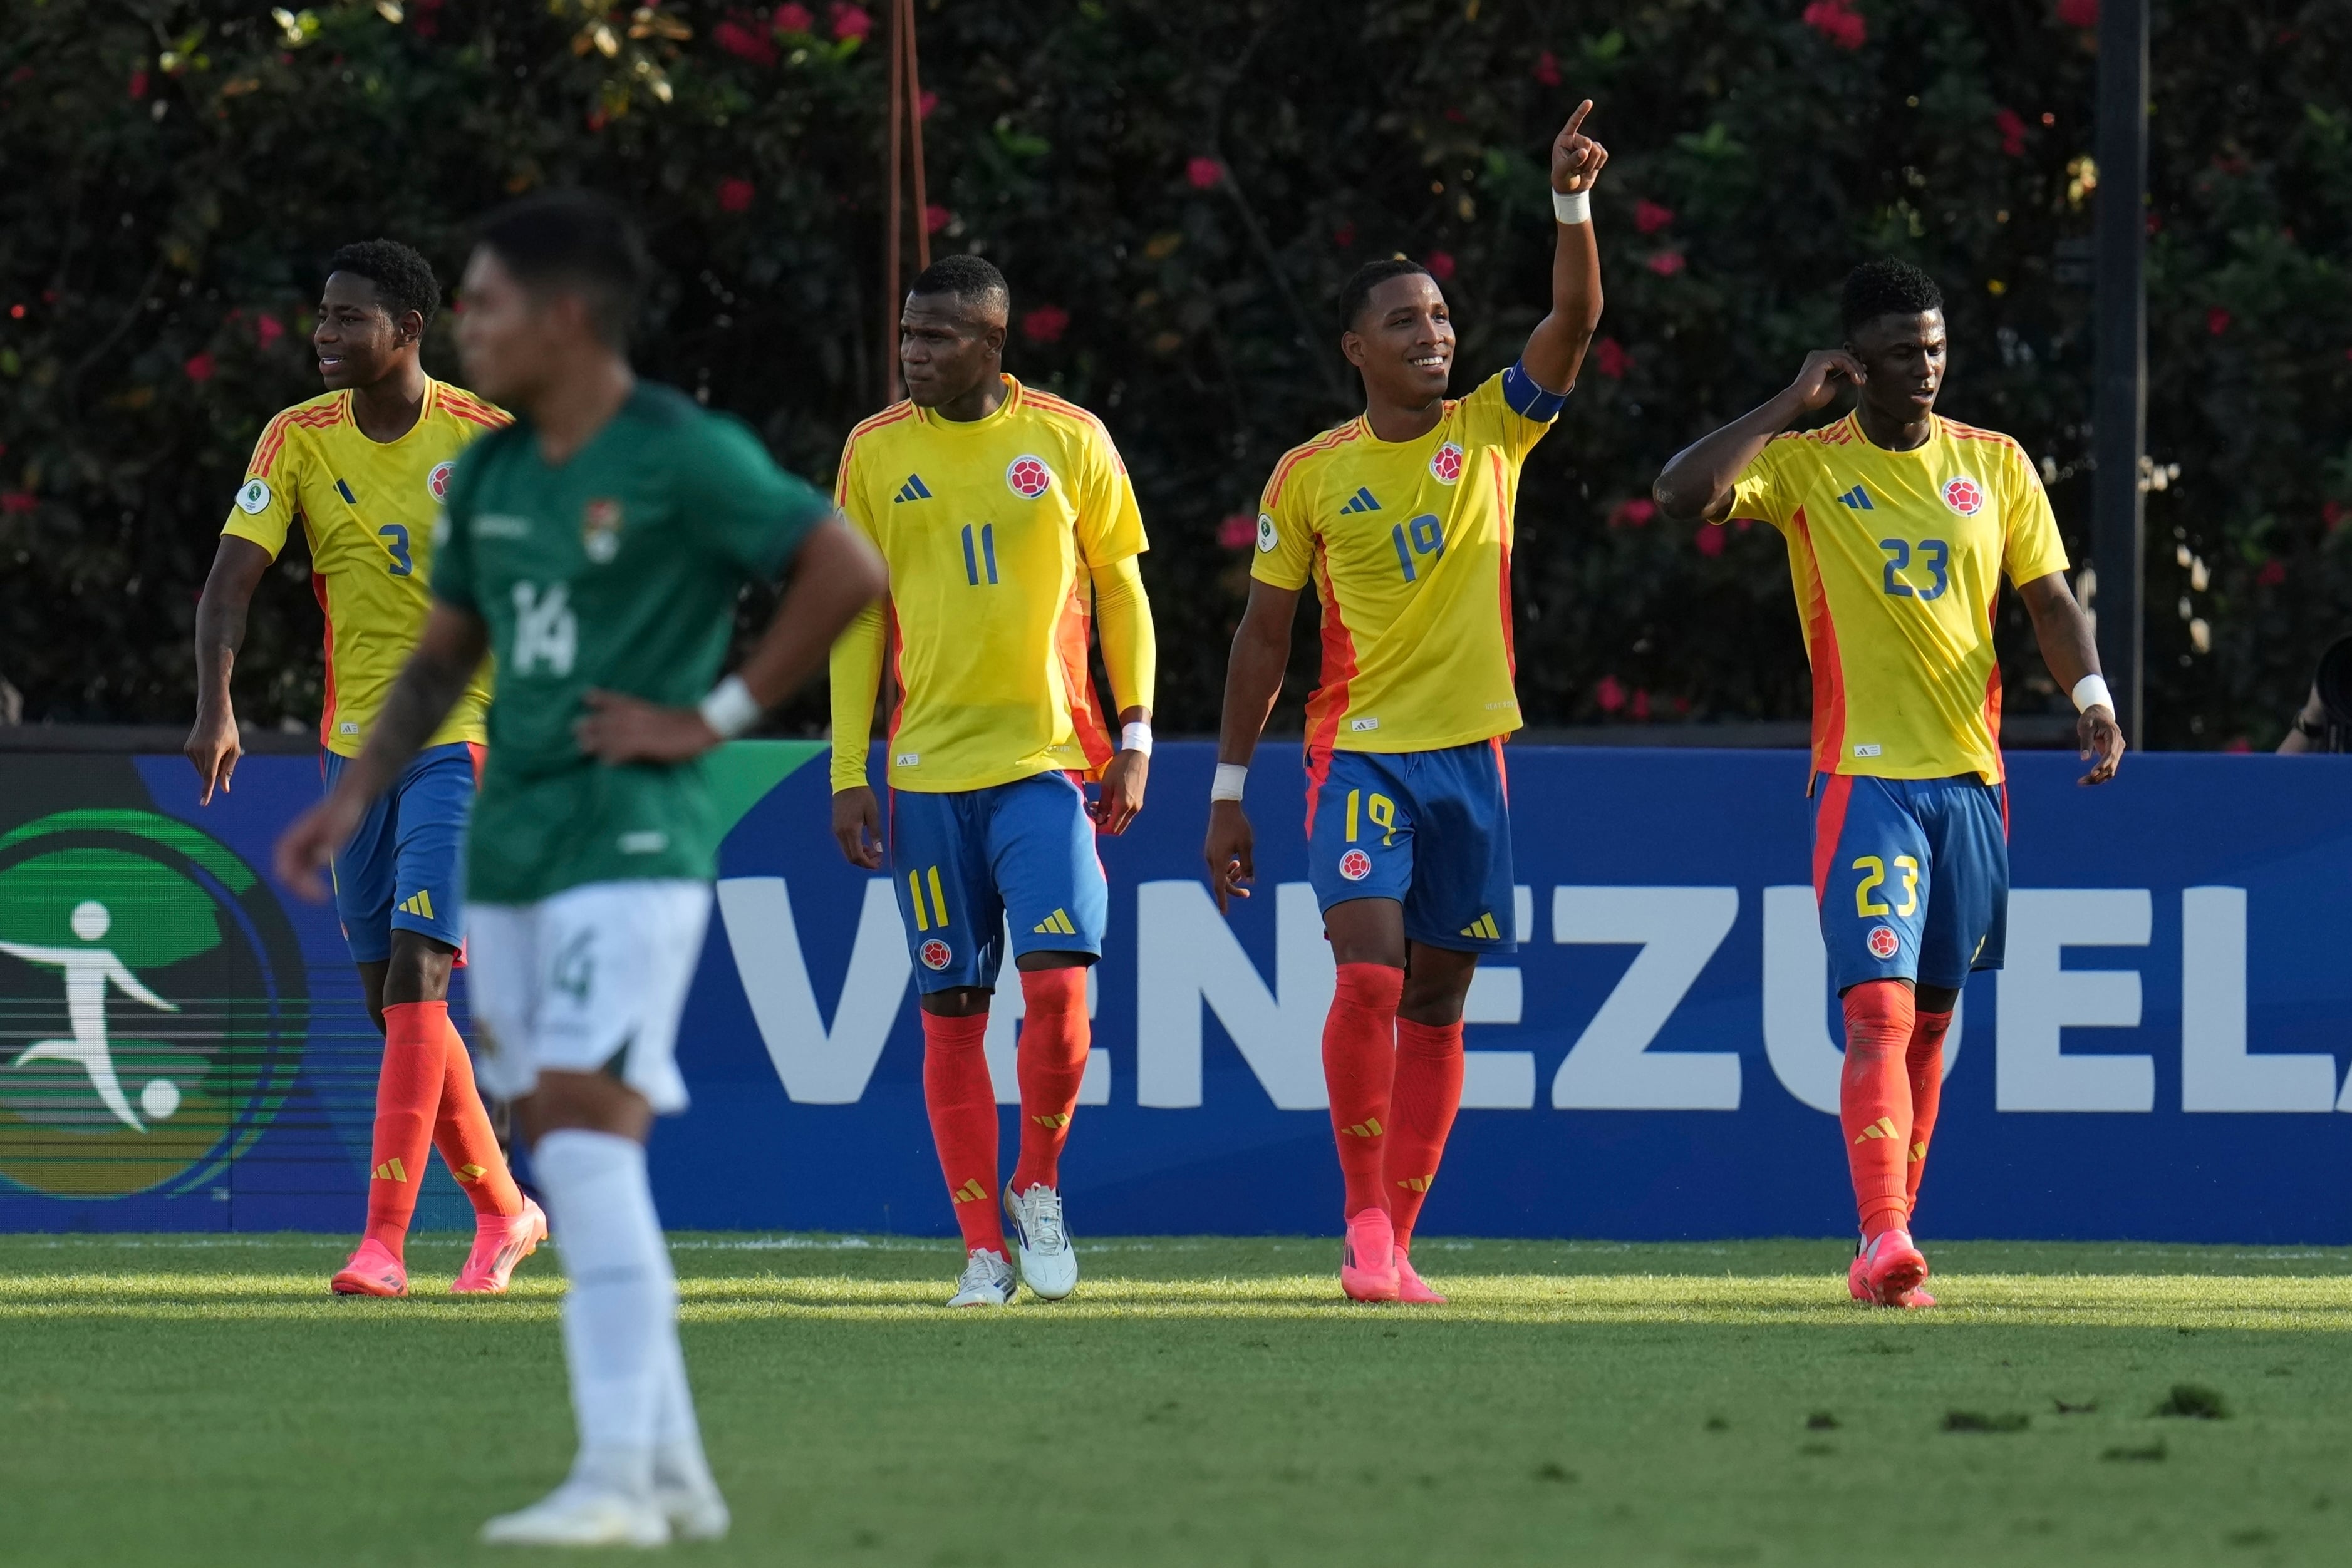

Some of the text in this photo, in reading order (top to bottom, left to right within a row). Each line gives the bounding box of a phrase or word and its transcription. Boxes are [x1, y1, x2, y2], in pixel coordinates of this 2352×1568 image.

[378, 524, 412, 576] 3
[961, 523, 998, 585] 11
[1392, 513, 1444, 582] 19
[1879, 539, 1949, 601] 23
[511, 581, 577, 676] 14
[1346, 789, 1397, 845] 19
[909, 865, 948, 931] 11
[1852, 855, 1918, 917] 23
[717, 877, 2352, 1112] VNZUEL
